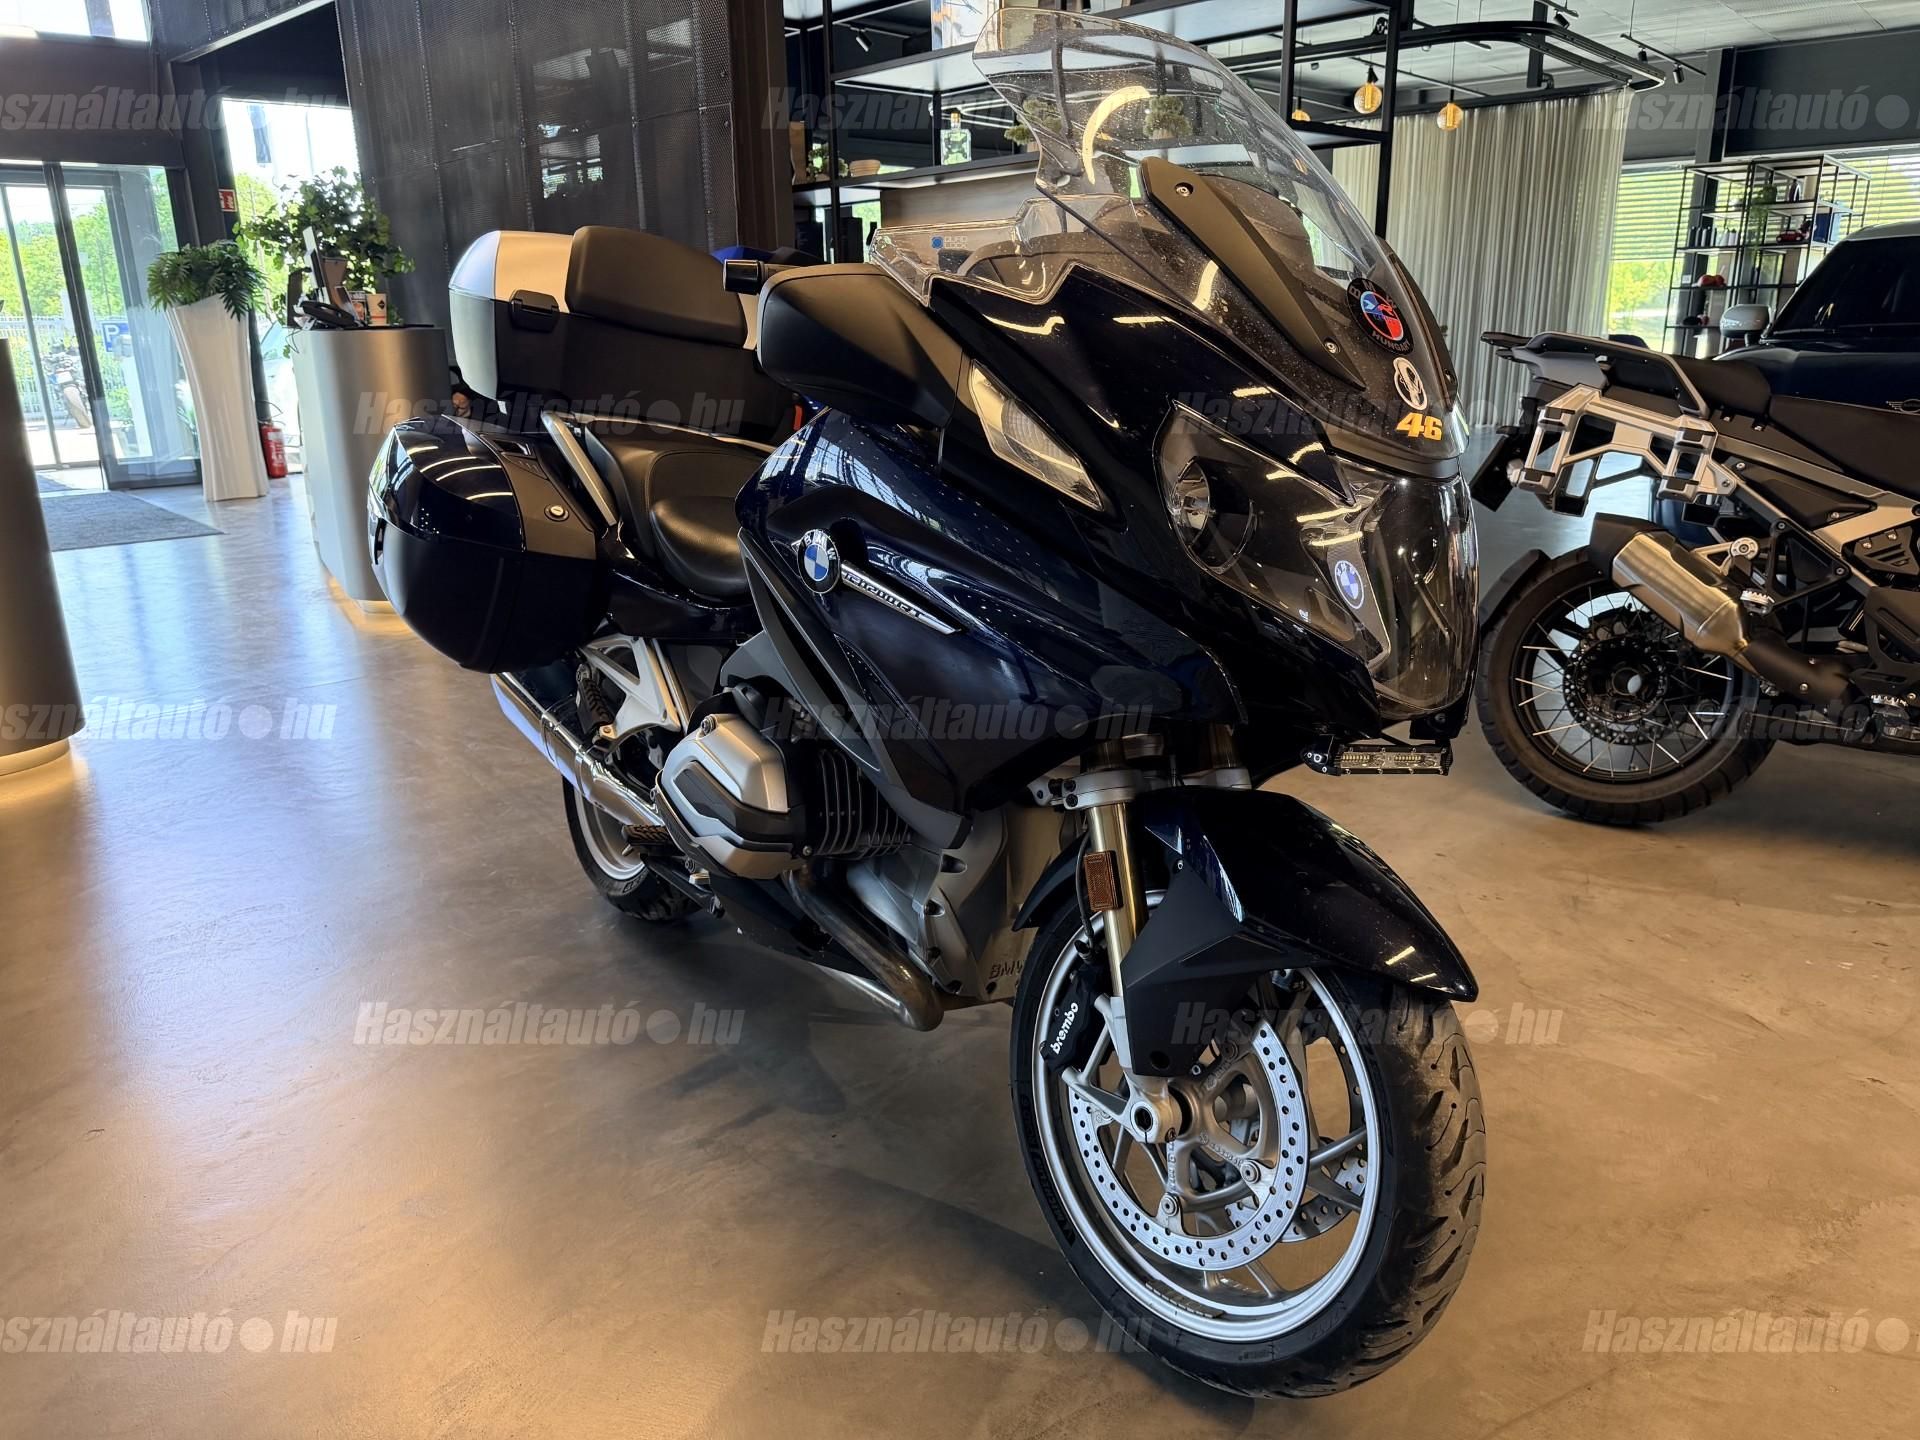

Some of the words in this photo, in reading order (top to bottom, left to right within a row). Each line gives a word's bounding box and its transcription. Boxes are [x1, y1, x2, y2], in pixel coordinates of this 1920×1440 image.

[1395, 412, 1443, 441] 46
[804, 530, 837, 561] BMW
[1049, 1001, 1080, 1055] brembo
